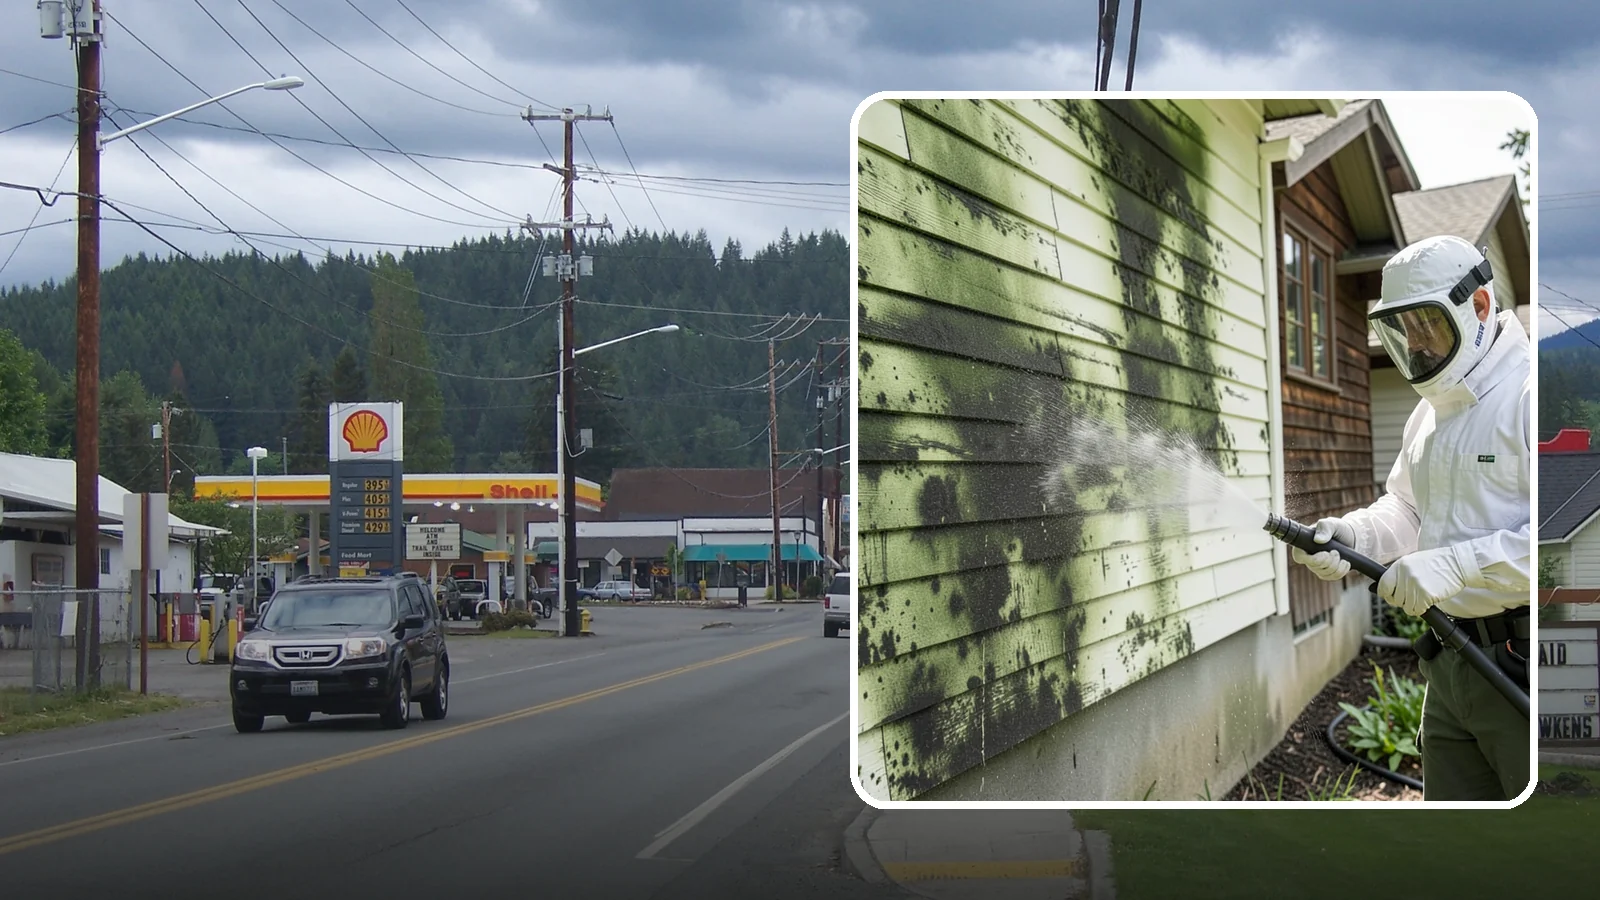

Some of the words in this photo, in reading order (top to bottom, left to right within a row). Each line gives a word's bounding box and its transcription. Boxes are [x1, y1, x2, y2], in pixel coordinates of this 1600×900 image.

[366, 480, 383, 490] 395
[490, 484, 547, 499] Shell
[366, 494, 383, 504] 405
[366, 508, 383, 518] 415
[366, 522, 383, 532] 429
